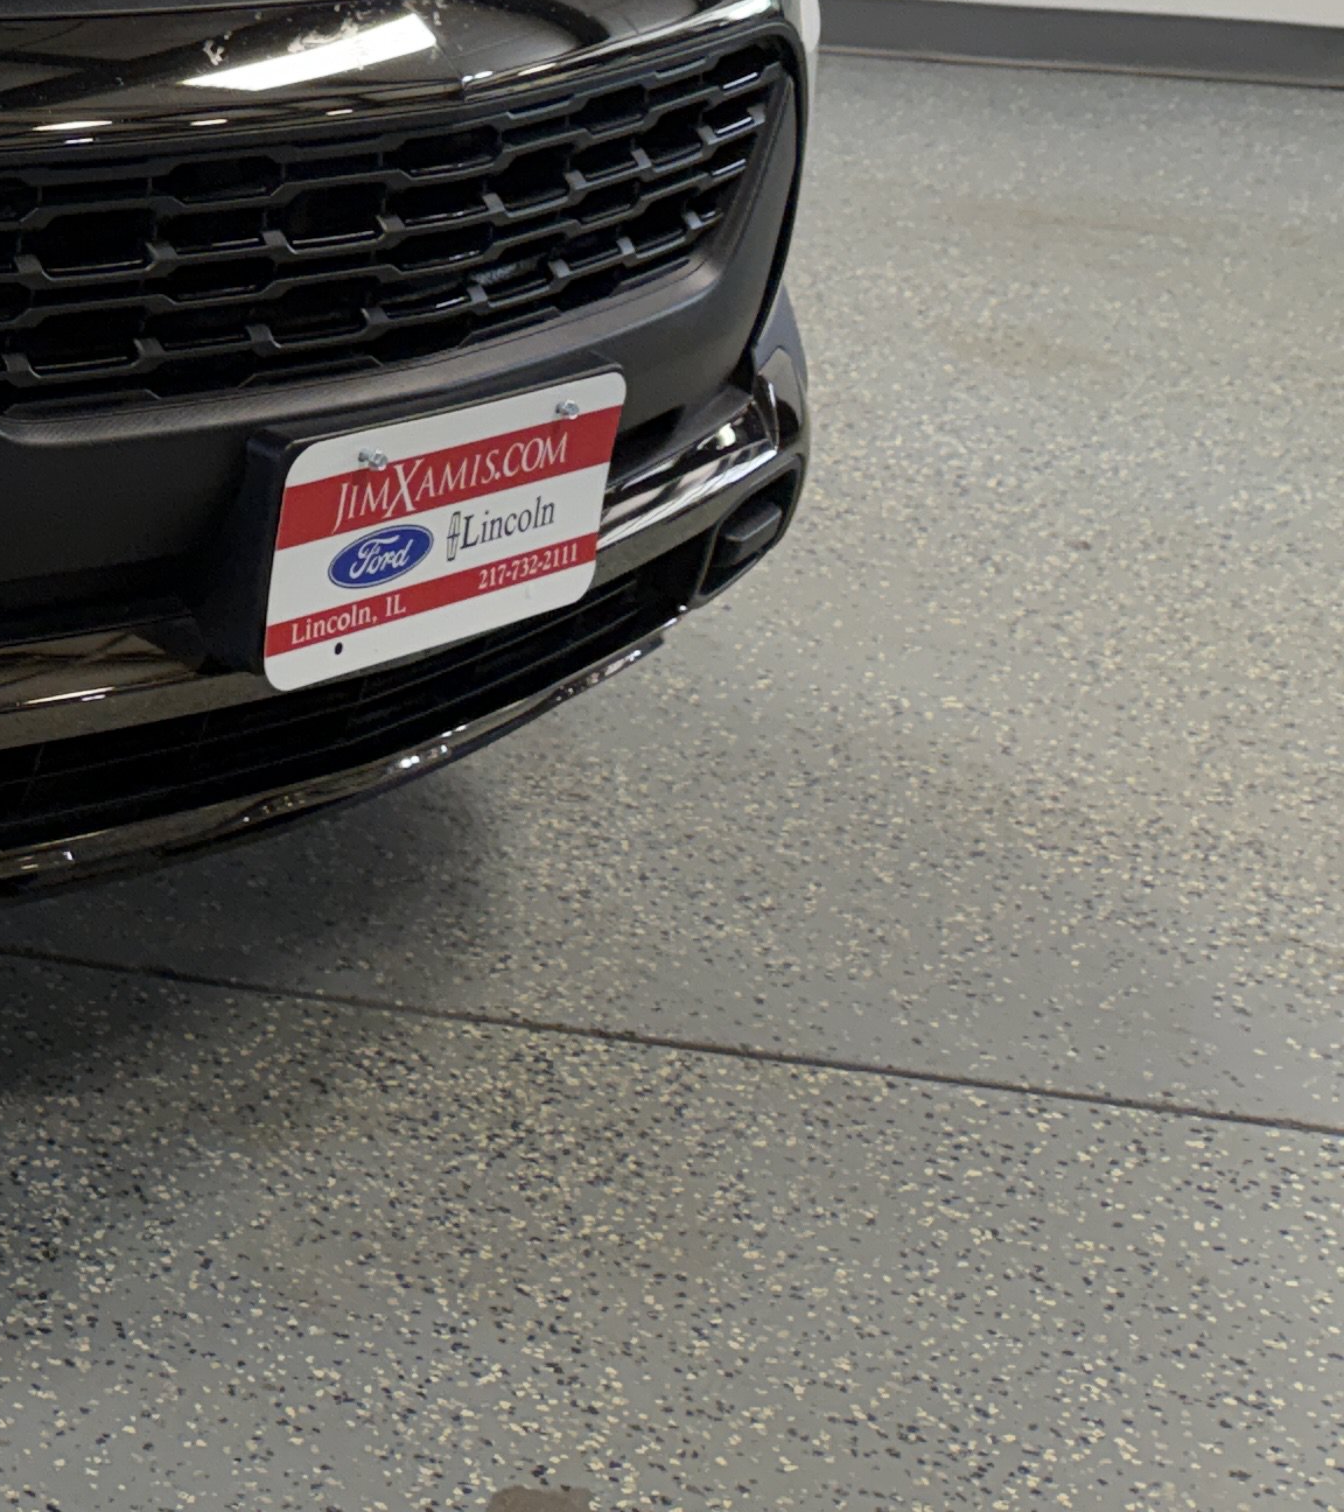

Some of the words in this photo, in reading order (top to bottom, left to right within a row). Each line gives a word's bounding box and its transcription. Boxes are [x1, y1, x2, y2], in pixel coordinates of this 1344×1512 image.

[459, 495, 556, 551] Lincoln
[348, 533, 414, 580] Ford
[478, 544, 578, 590] 217-732-2111
[290, 603, 378, 645] Lincoln,
[384, 594, 407, 625] IL
